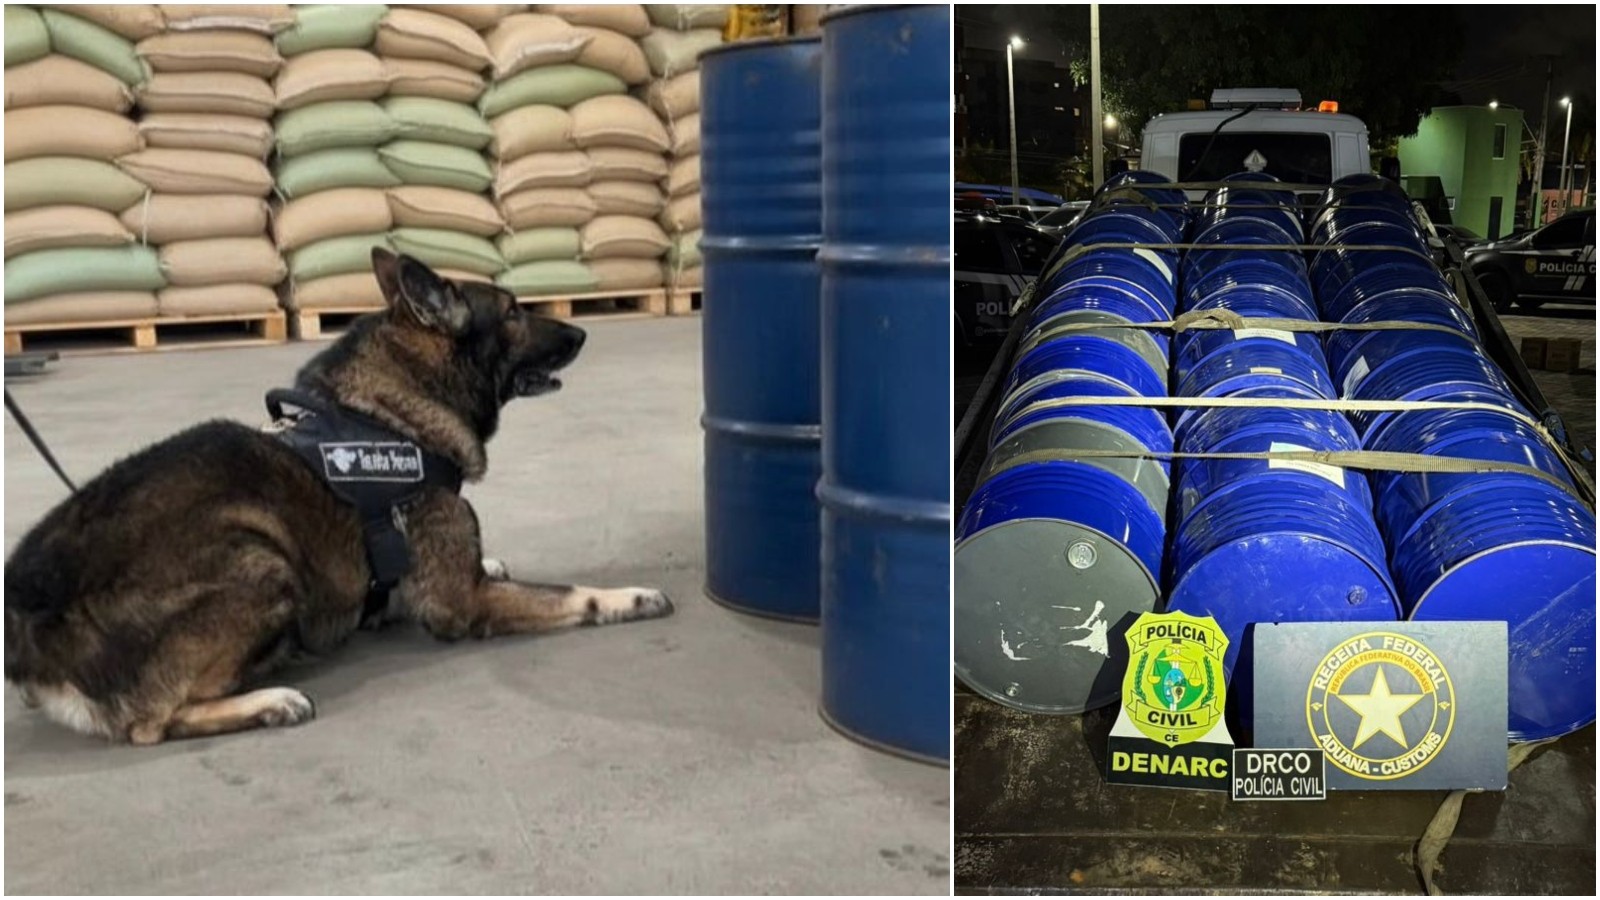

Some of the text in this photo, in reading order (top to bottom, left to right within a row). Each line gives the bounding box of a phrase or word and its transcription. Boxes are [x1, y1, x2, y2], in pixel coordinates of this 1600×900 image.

[1540, 261, 1585, 273] POLÍCIA
[1146, 621, 1207, 644] POLÍCIA
[1314, 636, 1447, 690] RECEITA FEDERAL
[1360, 652, 1403, 664] FEDERATIVA
[1404, 659, 1416, 671] DO
[1415, 668, 1431, 692] BRASIL
[1147, 711, 1197, 727] CIVIL
[1164, 733, 1179, 743] CE
[1247, 752, 1311, 774] DRCO
[1318, 733, 1370, 774] ADUANA
[1380, 731, 1442, 775] CUSTOMS
[1112, 751, 1228, 779] DENARC
[1235, 774, 1323, 796] POLÍCIA CIVIL
